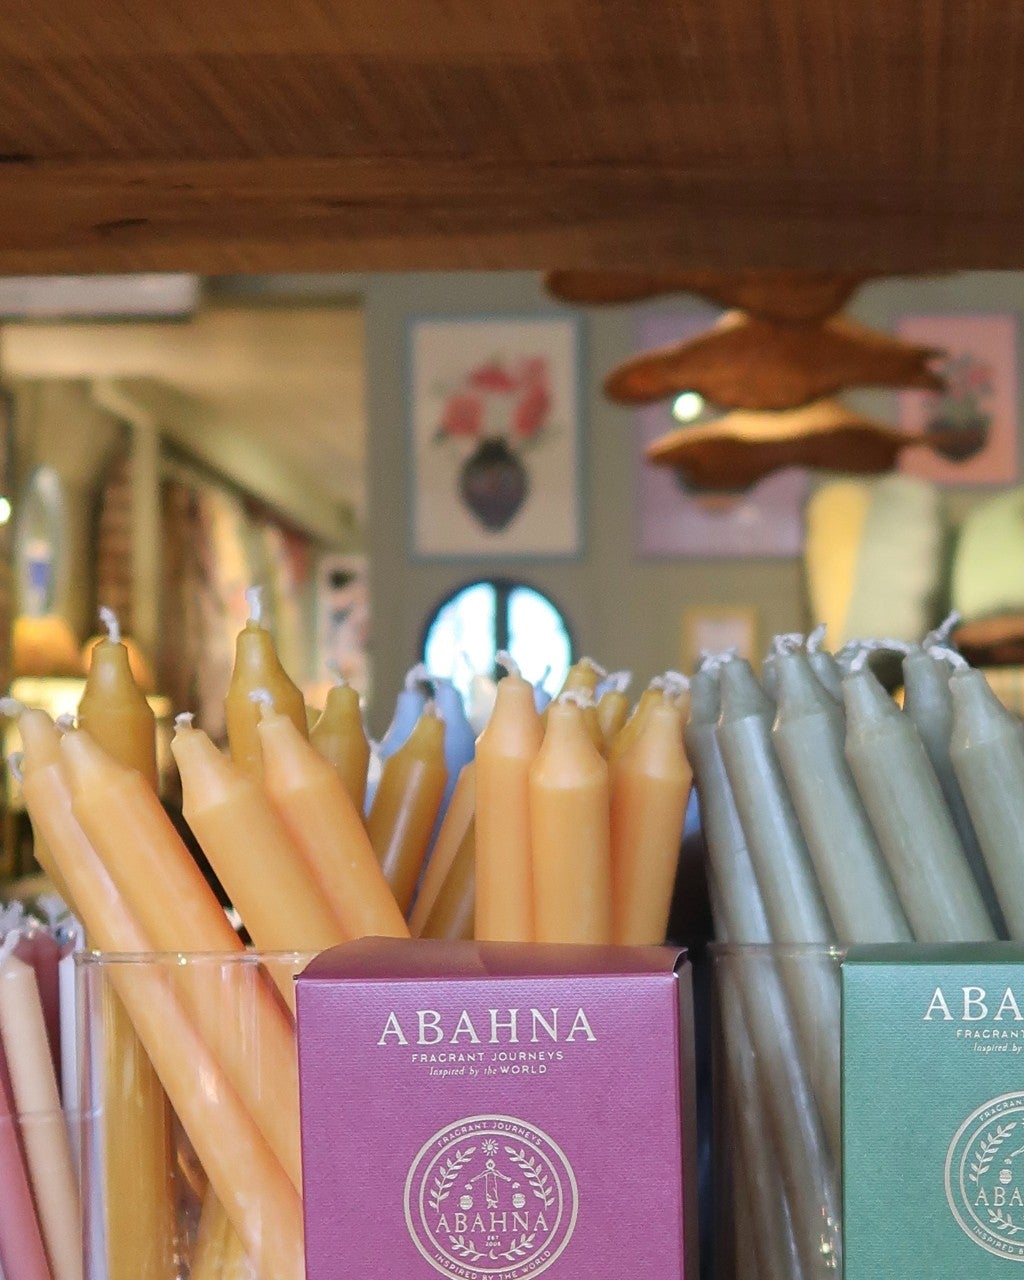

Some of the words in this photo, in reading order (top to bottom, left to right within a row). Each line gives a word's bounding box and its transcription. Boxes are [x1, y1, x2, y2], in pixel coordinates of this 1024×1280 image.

[377, 1007, 597, 1045] ABAHNA
[411, 1052, 485, 1063] FRAGRANT
[491, 1050, 564, 1062] JOURNEYS
[973, 1043, 1008, 1055] Inspired
[1012, 1043, 1023, 1054] by
[429, 1066, 465, 1078] Inspired
[469, 1066, 480, 1077] by
[484, 1065, 498, 1075] the
[500, 1064, 547, 1074] WORLD
[437, 1122, 487, 1148] FRAGRANT
[492, 1122, 543, 1146] JOURNEYS
[435, 1211, 548, 1233] ABAHNA
[434, 1253, 477, 1280] INSPIRED
[499, 1271, 518, 1280] THE
[522, 1250, 551, 1273] WORLD
